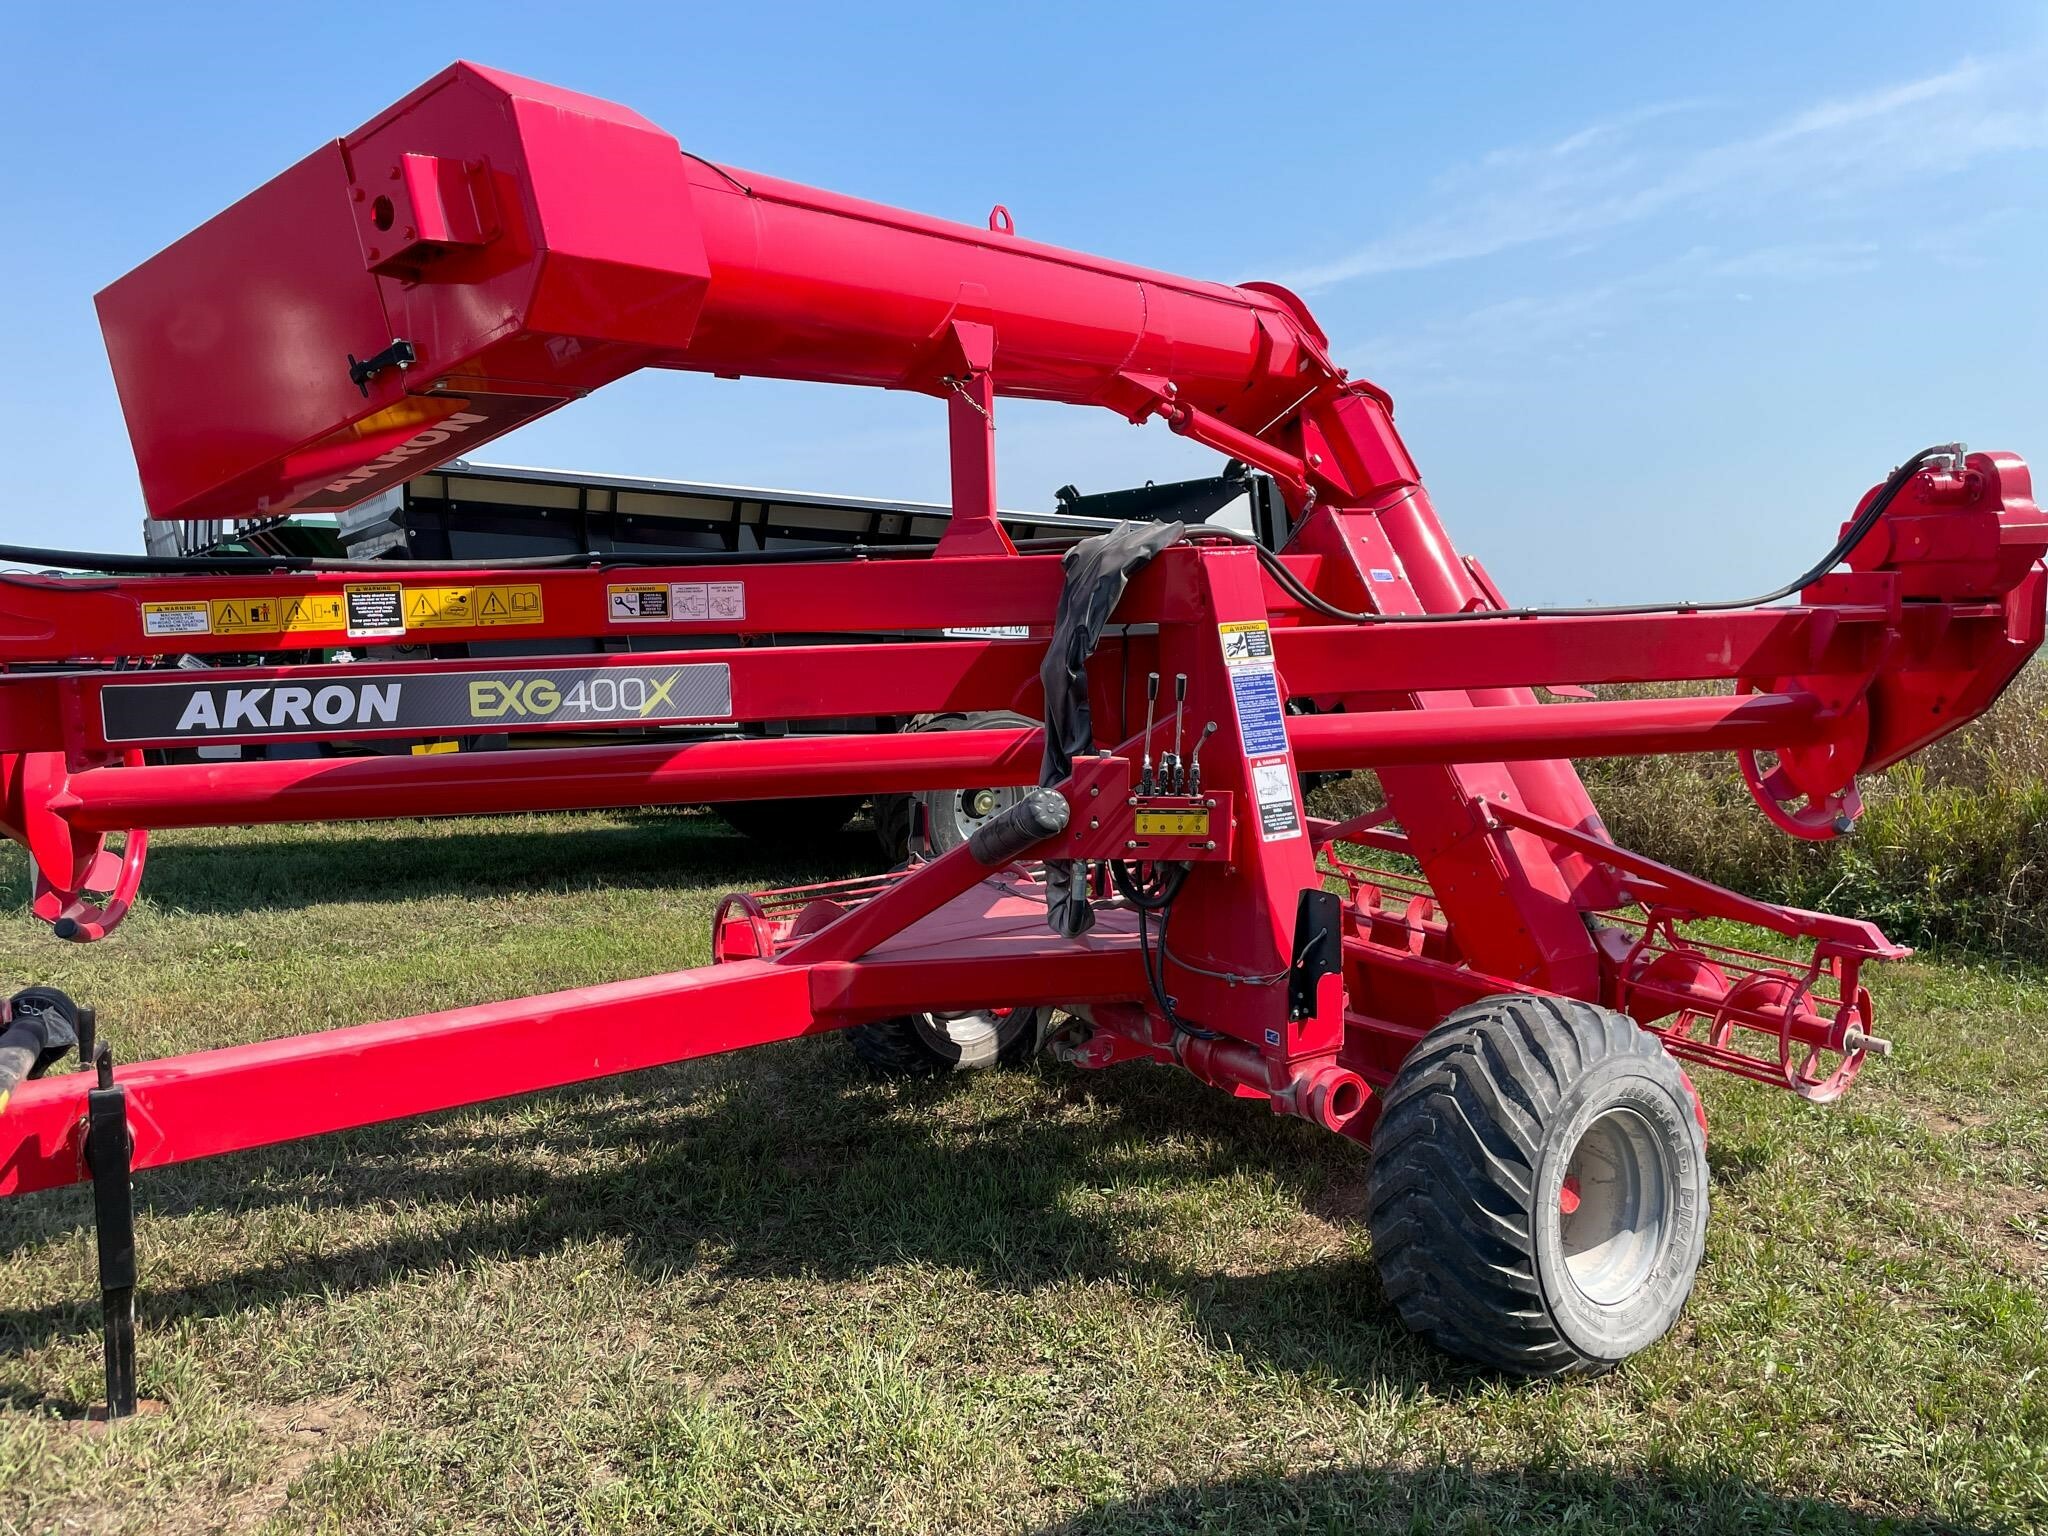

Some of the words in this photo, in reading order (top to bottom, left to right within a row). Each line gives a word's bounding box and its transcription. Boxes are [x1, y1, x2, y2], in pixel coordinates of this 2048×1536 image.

[326, 412, 489, 492] AKRON
[176, 683, 402, 730] AKRON
[469, 669, 683, 718] EXG400X
